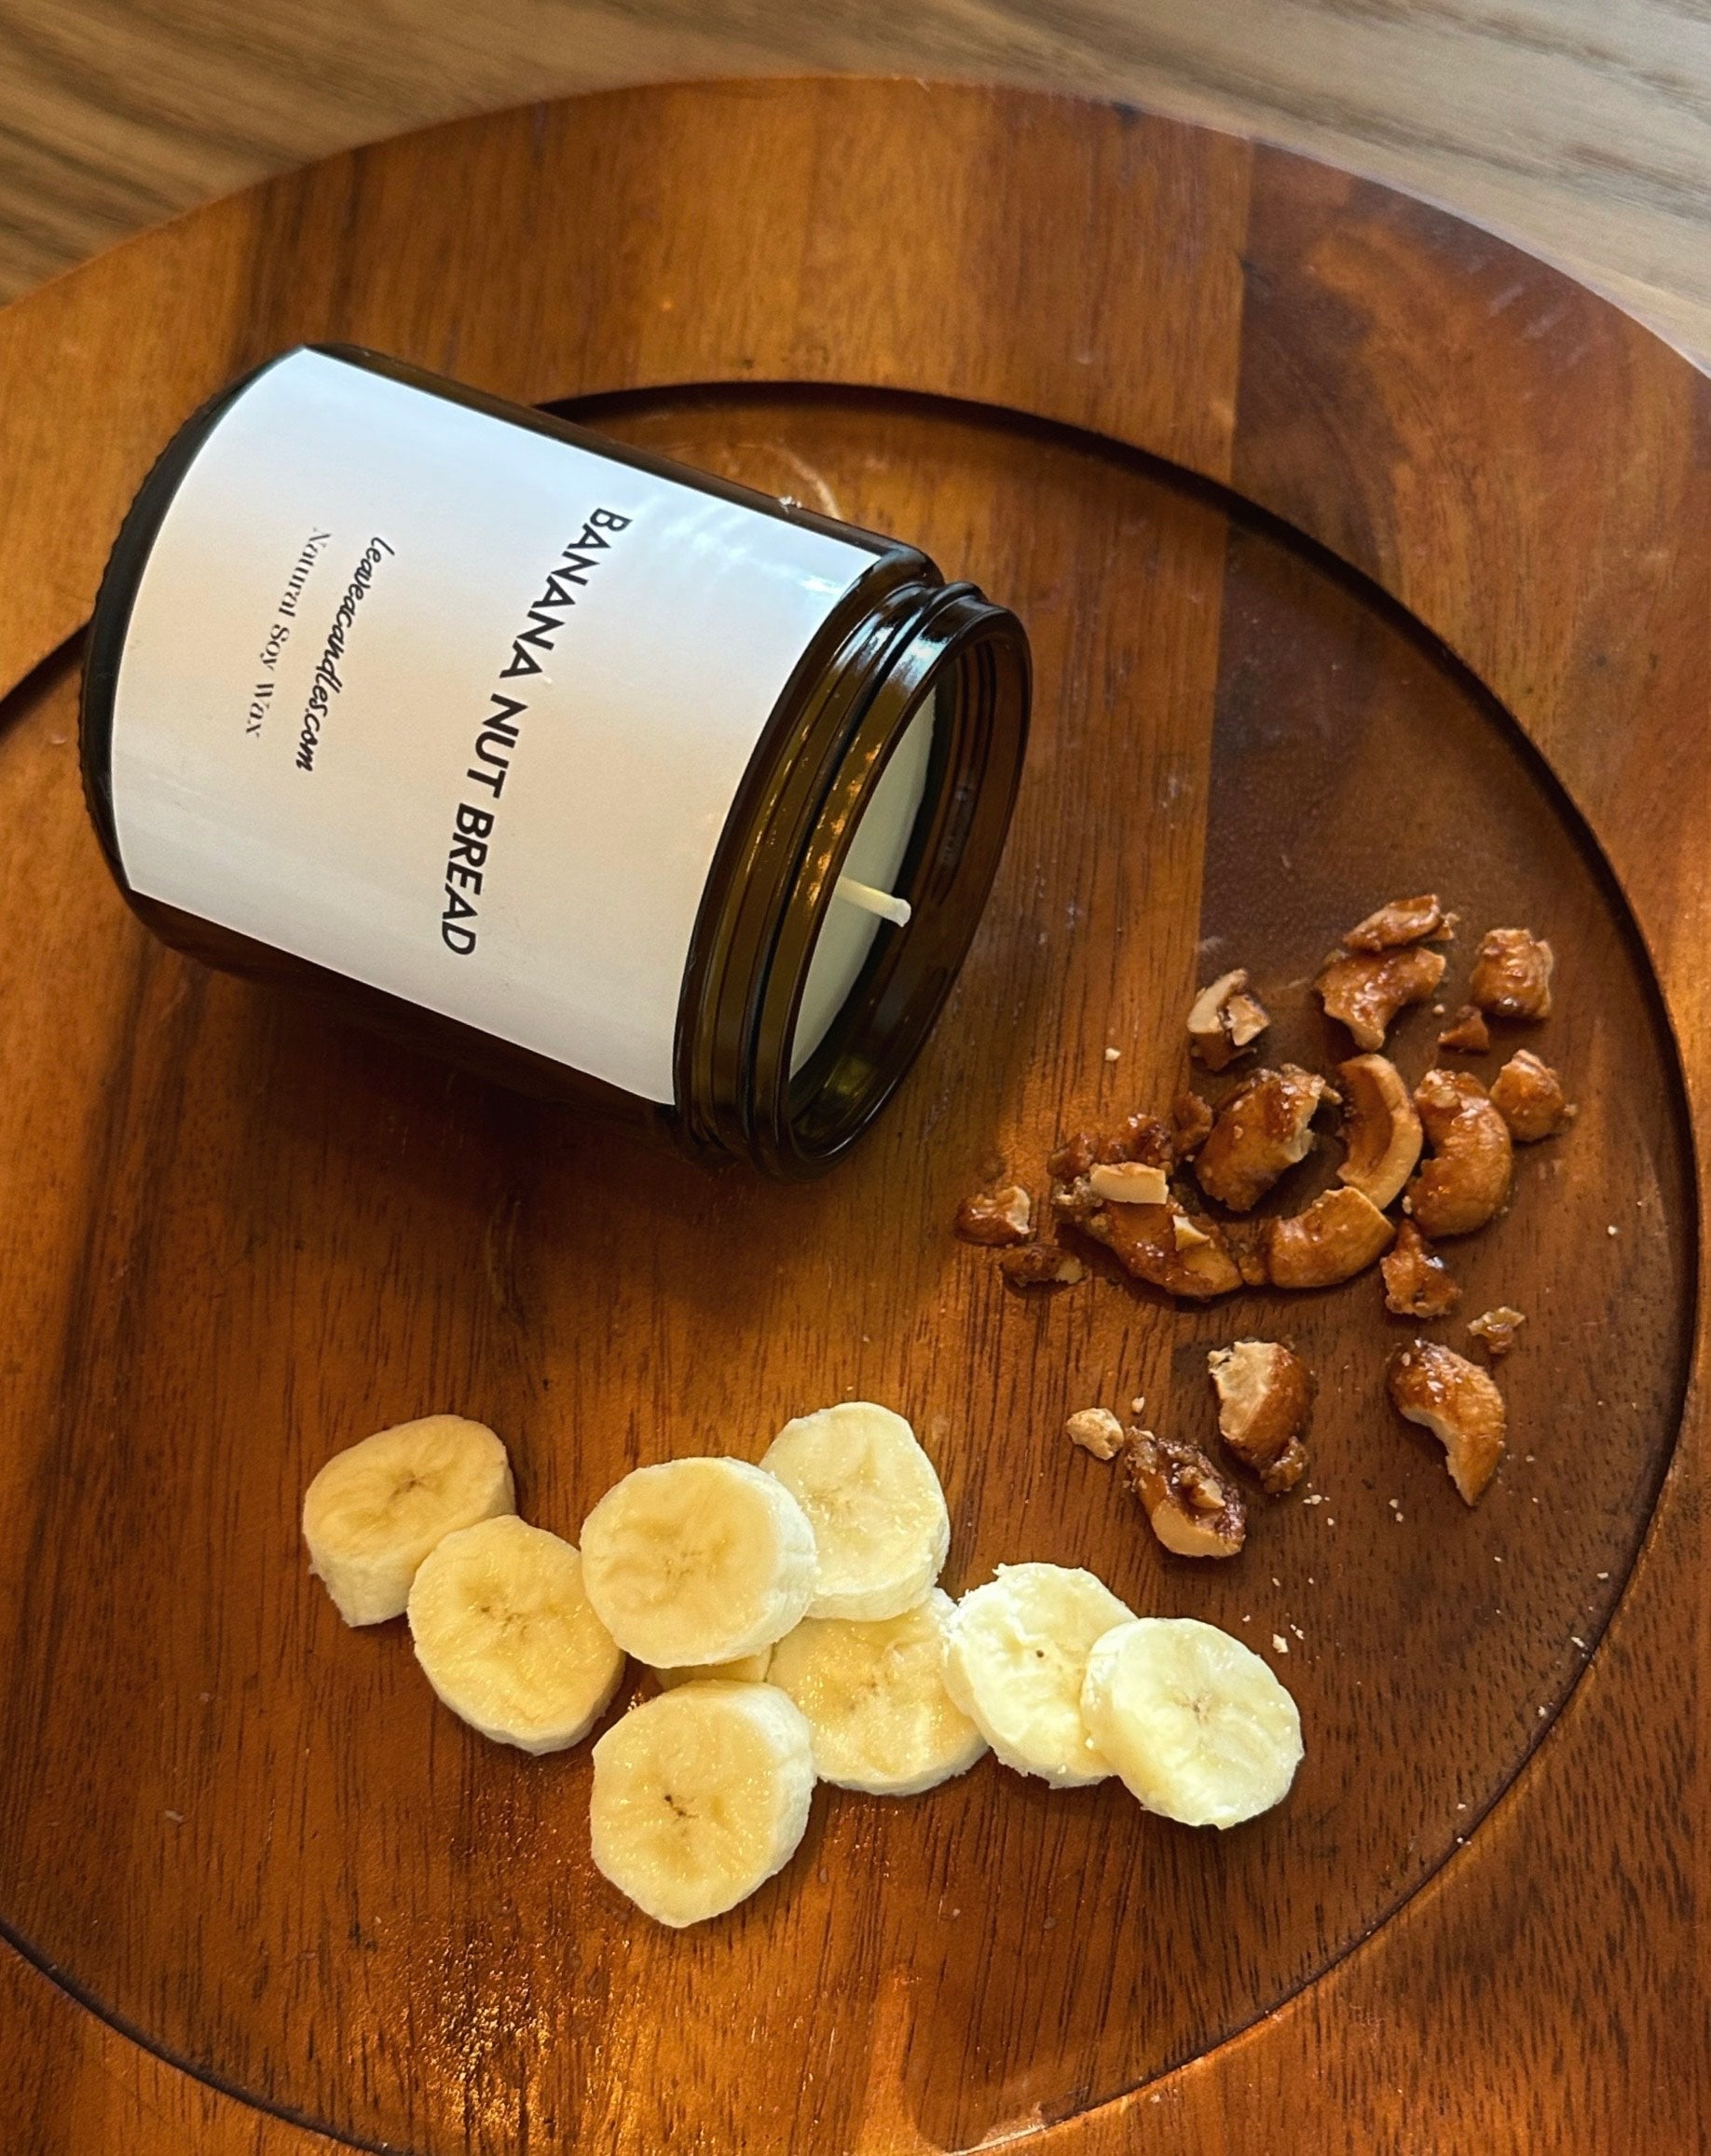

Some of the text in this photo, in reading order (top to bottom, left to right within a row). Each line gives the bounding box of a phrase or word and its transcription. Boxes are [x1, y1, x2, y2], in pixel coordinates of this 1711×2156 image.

[245, 526, 333, 739] Natural Soy Wax
[295, 536, 395, 771] leaveacandles.com
[441, 507, 633, 956] BANANA NUT BREAD
